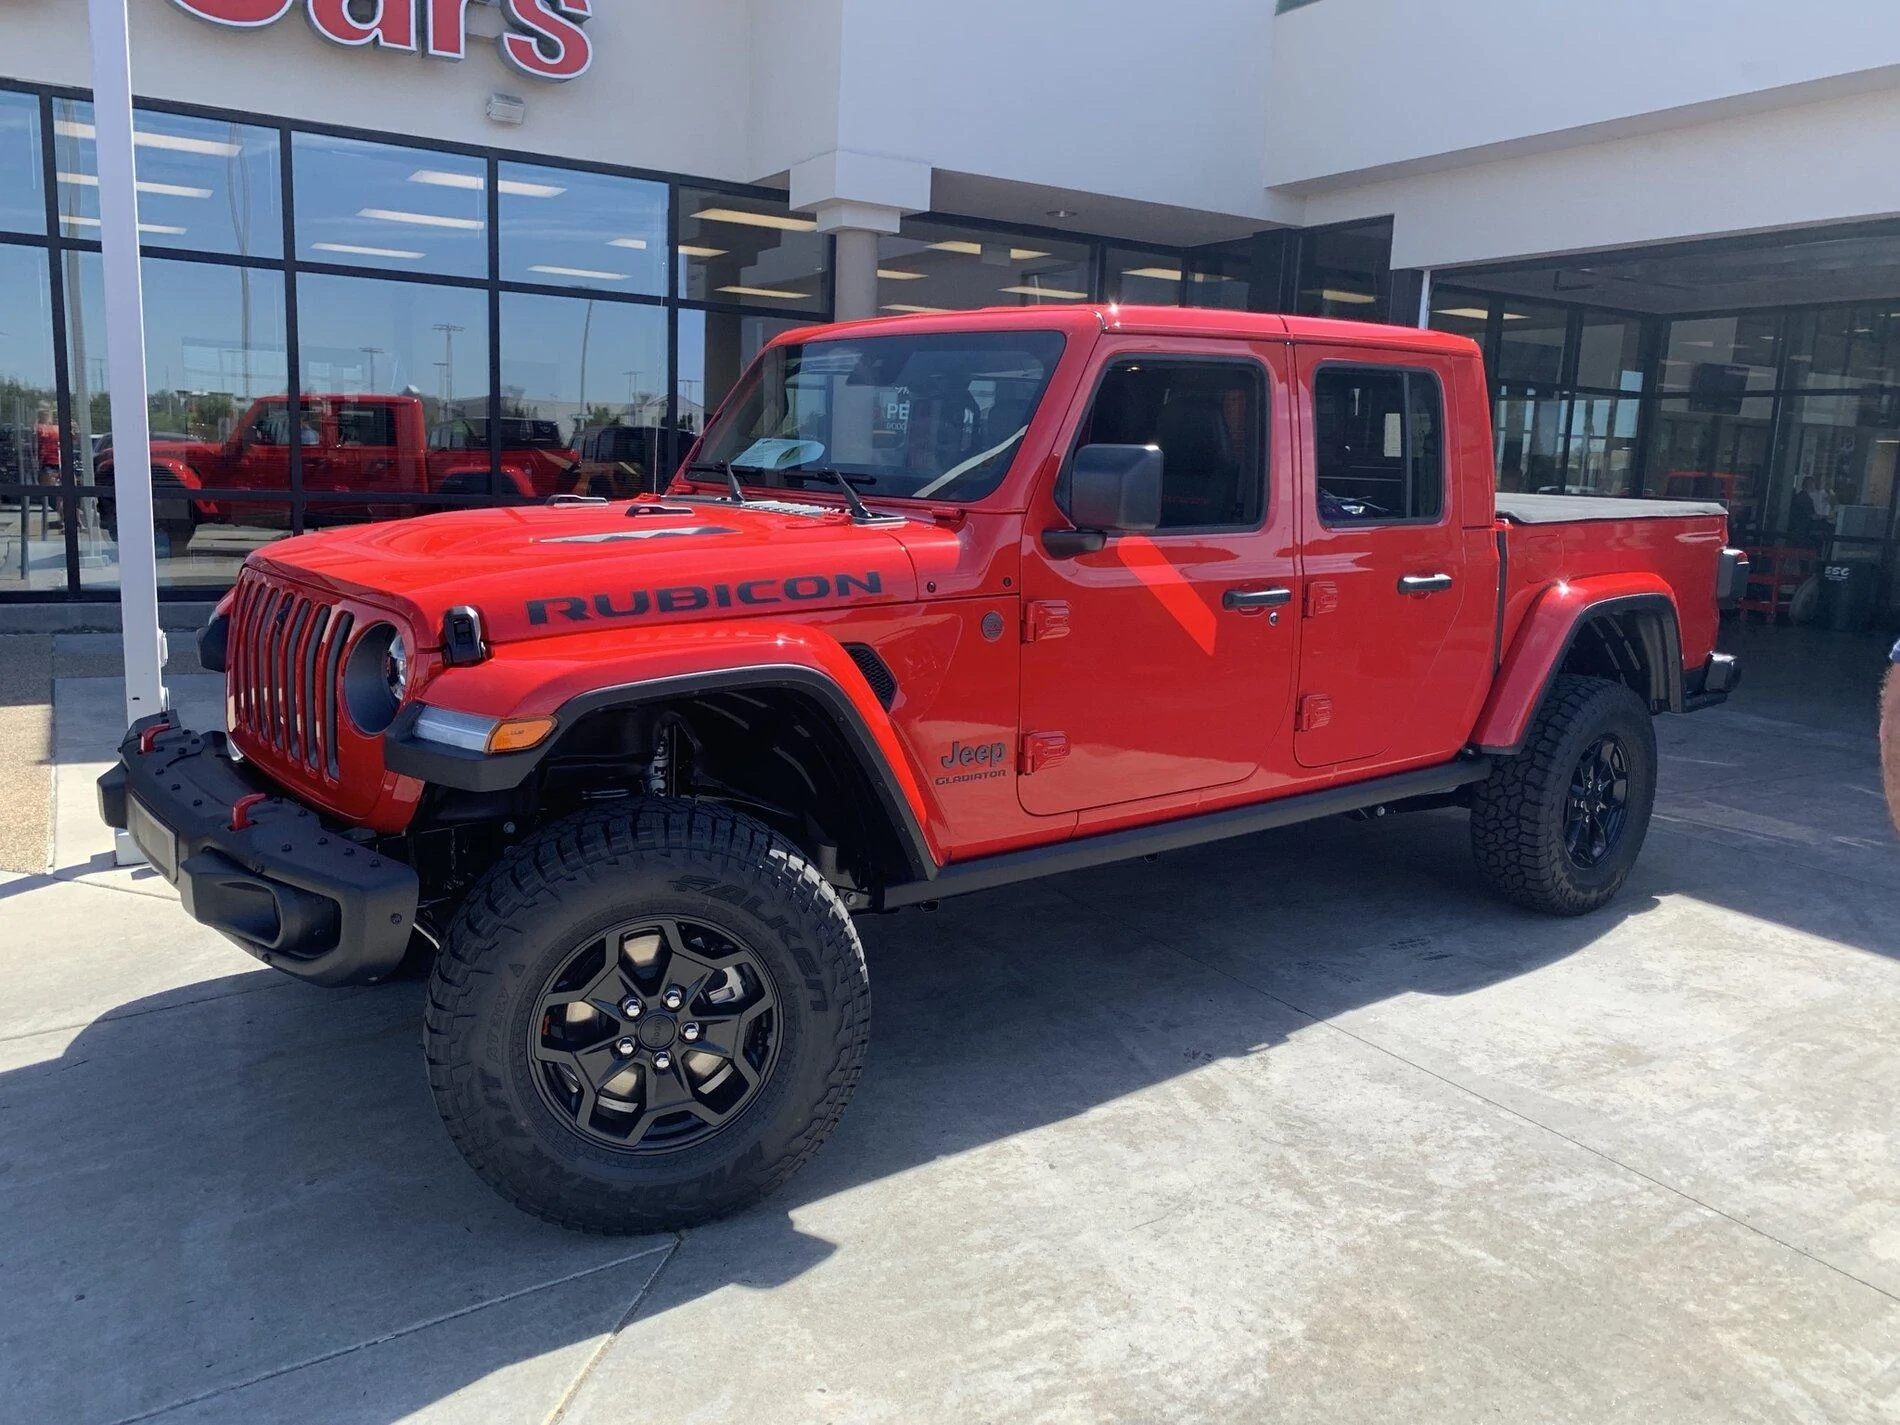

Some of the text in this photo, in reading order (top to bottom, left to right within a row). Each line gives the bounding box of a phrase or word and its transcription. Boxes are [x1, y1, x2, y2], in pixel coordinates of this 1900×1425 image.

[164, 0, 594, 82] ars
[524, 570, 883, 626] RUBICON
[941, 741, 1006, 769] Jeep
[935, 769, 1007, 786] GLADIATOR
